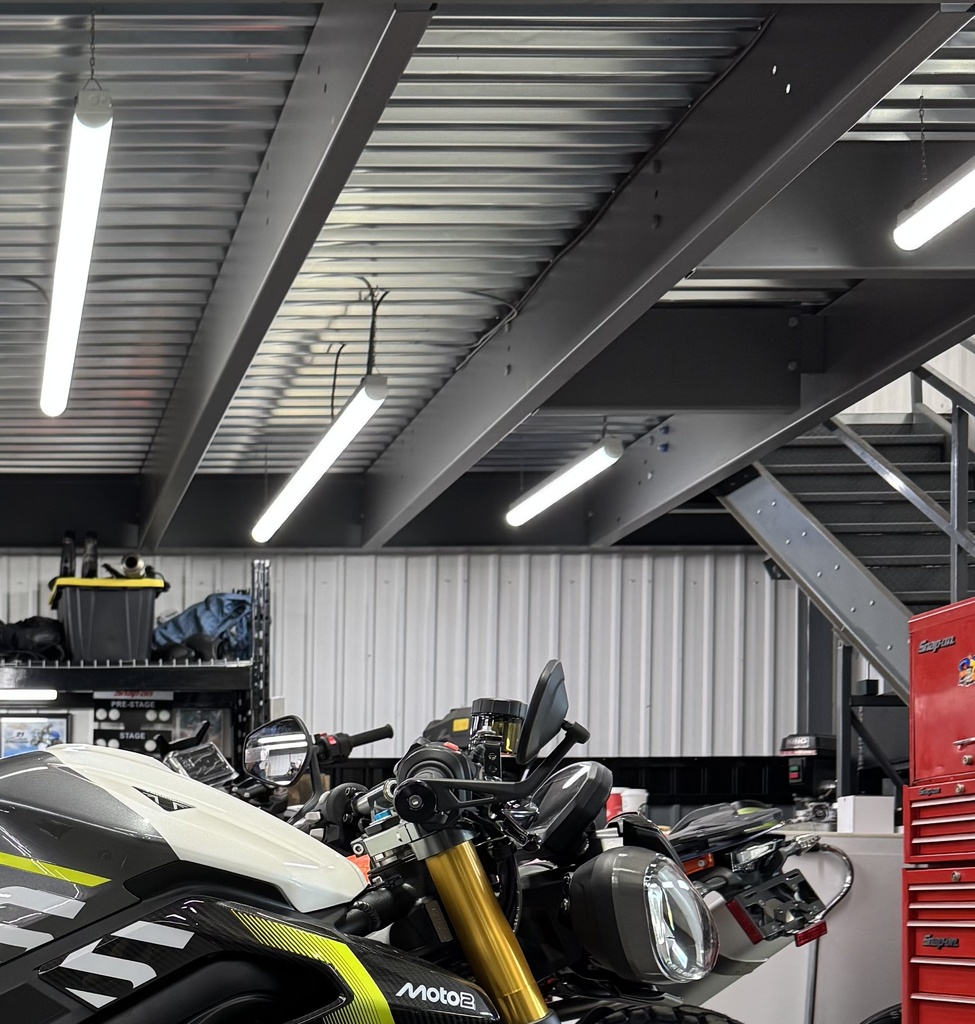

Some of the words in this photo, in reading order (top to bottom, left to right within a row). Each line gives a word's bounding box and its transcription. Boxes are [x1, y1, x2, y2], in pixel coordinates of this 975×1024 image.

[918, 636, 956, 654] Snap-on
[110, 700, 156, 709] PRE-STAGE
[119, 732, 146, 740] STAGE
[922, 934, 960, 949] Snap-on
[395, 982, 476, 1010] Moto2
